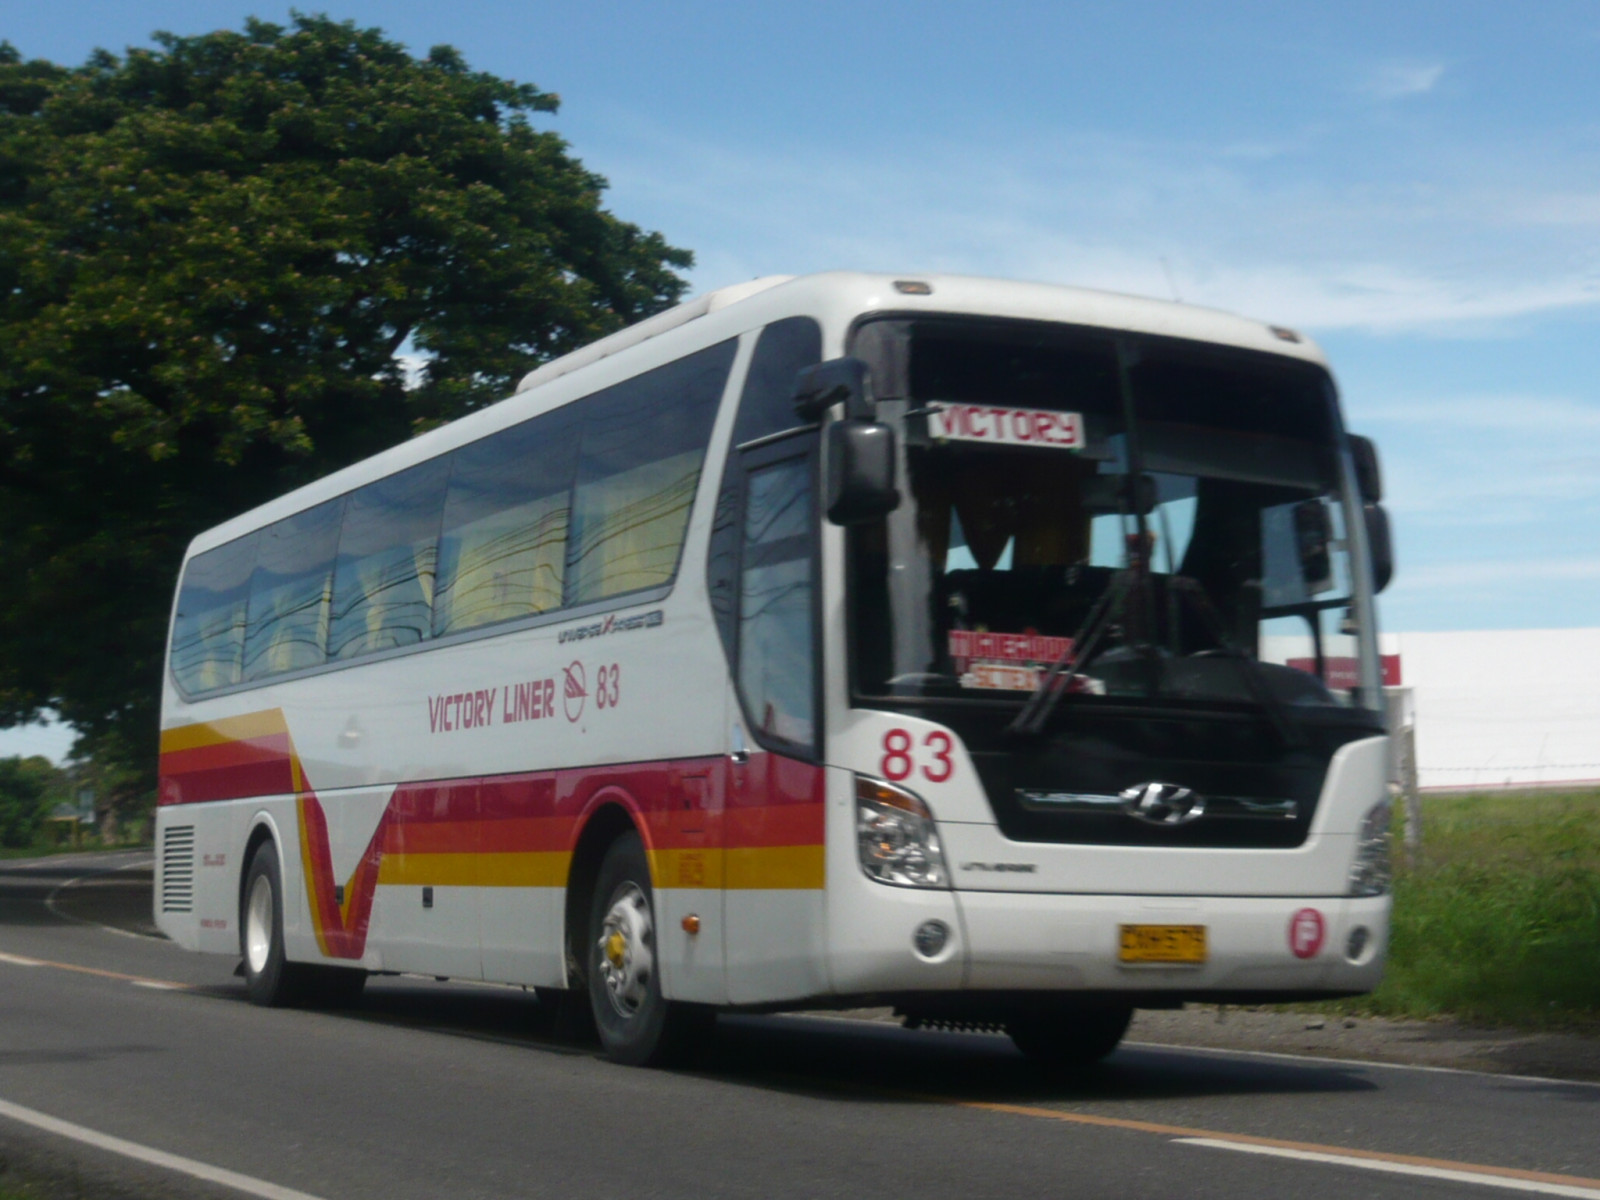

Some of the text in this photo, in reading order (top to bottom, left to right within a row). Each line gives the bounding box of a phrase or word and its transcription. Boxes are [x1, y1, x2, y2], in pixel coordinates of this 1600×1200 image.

[938, 404, 1077, 445] VICTORY
[428, 663, 620, 733] VICTORY LINER 83
[881, 727, 953, 783] 83
